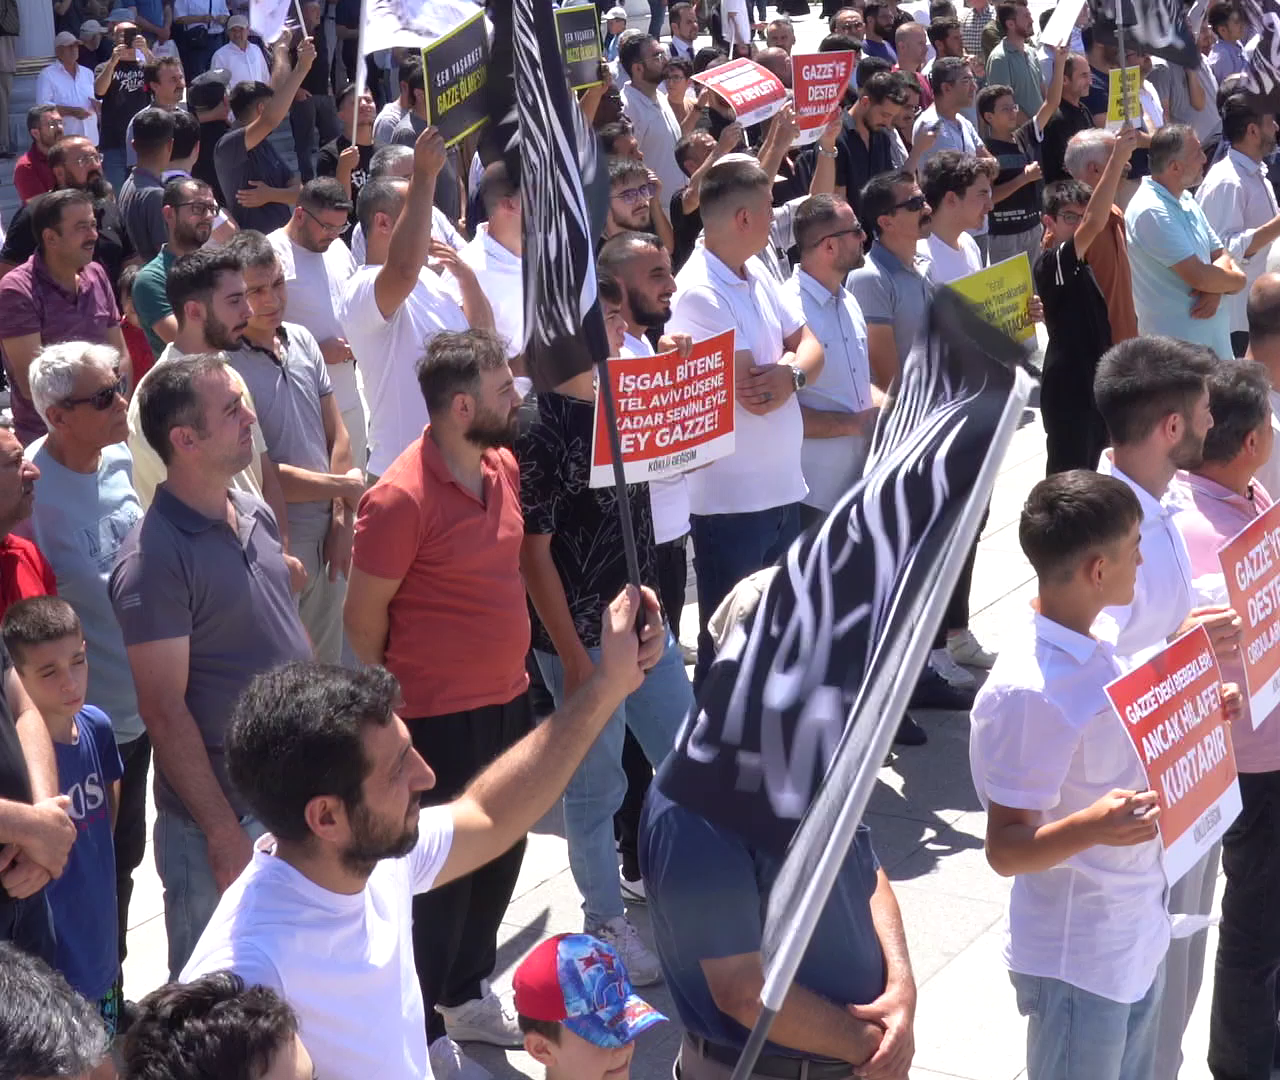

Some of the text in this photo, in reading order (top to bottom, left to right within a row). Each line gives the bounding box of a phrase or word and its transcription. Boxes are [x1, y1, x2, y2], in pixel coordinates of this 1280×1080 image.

[436, 67, 450, 87] SEN
[808, 83, 840, 101] DESTEK
[437, 83, 461, 116] GAZZE
[618, 351, 725, 396] İŞGAL BİTENE,
[618, 372, 725, 413] TEL AVİV DÜŞENE
[666, 390, 727, 424] SENİNLEYİZ
[620, 409, 719, 454] EY GAZZE!
[1125, 674, 1177, 725] GAZZE'DEKİ
[1140, 680, 1222, 765] ANCAK HİLAFET
[1160, 725, 1228, 809] KURTARIR
